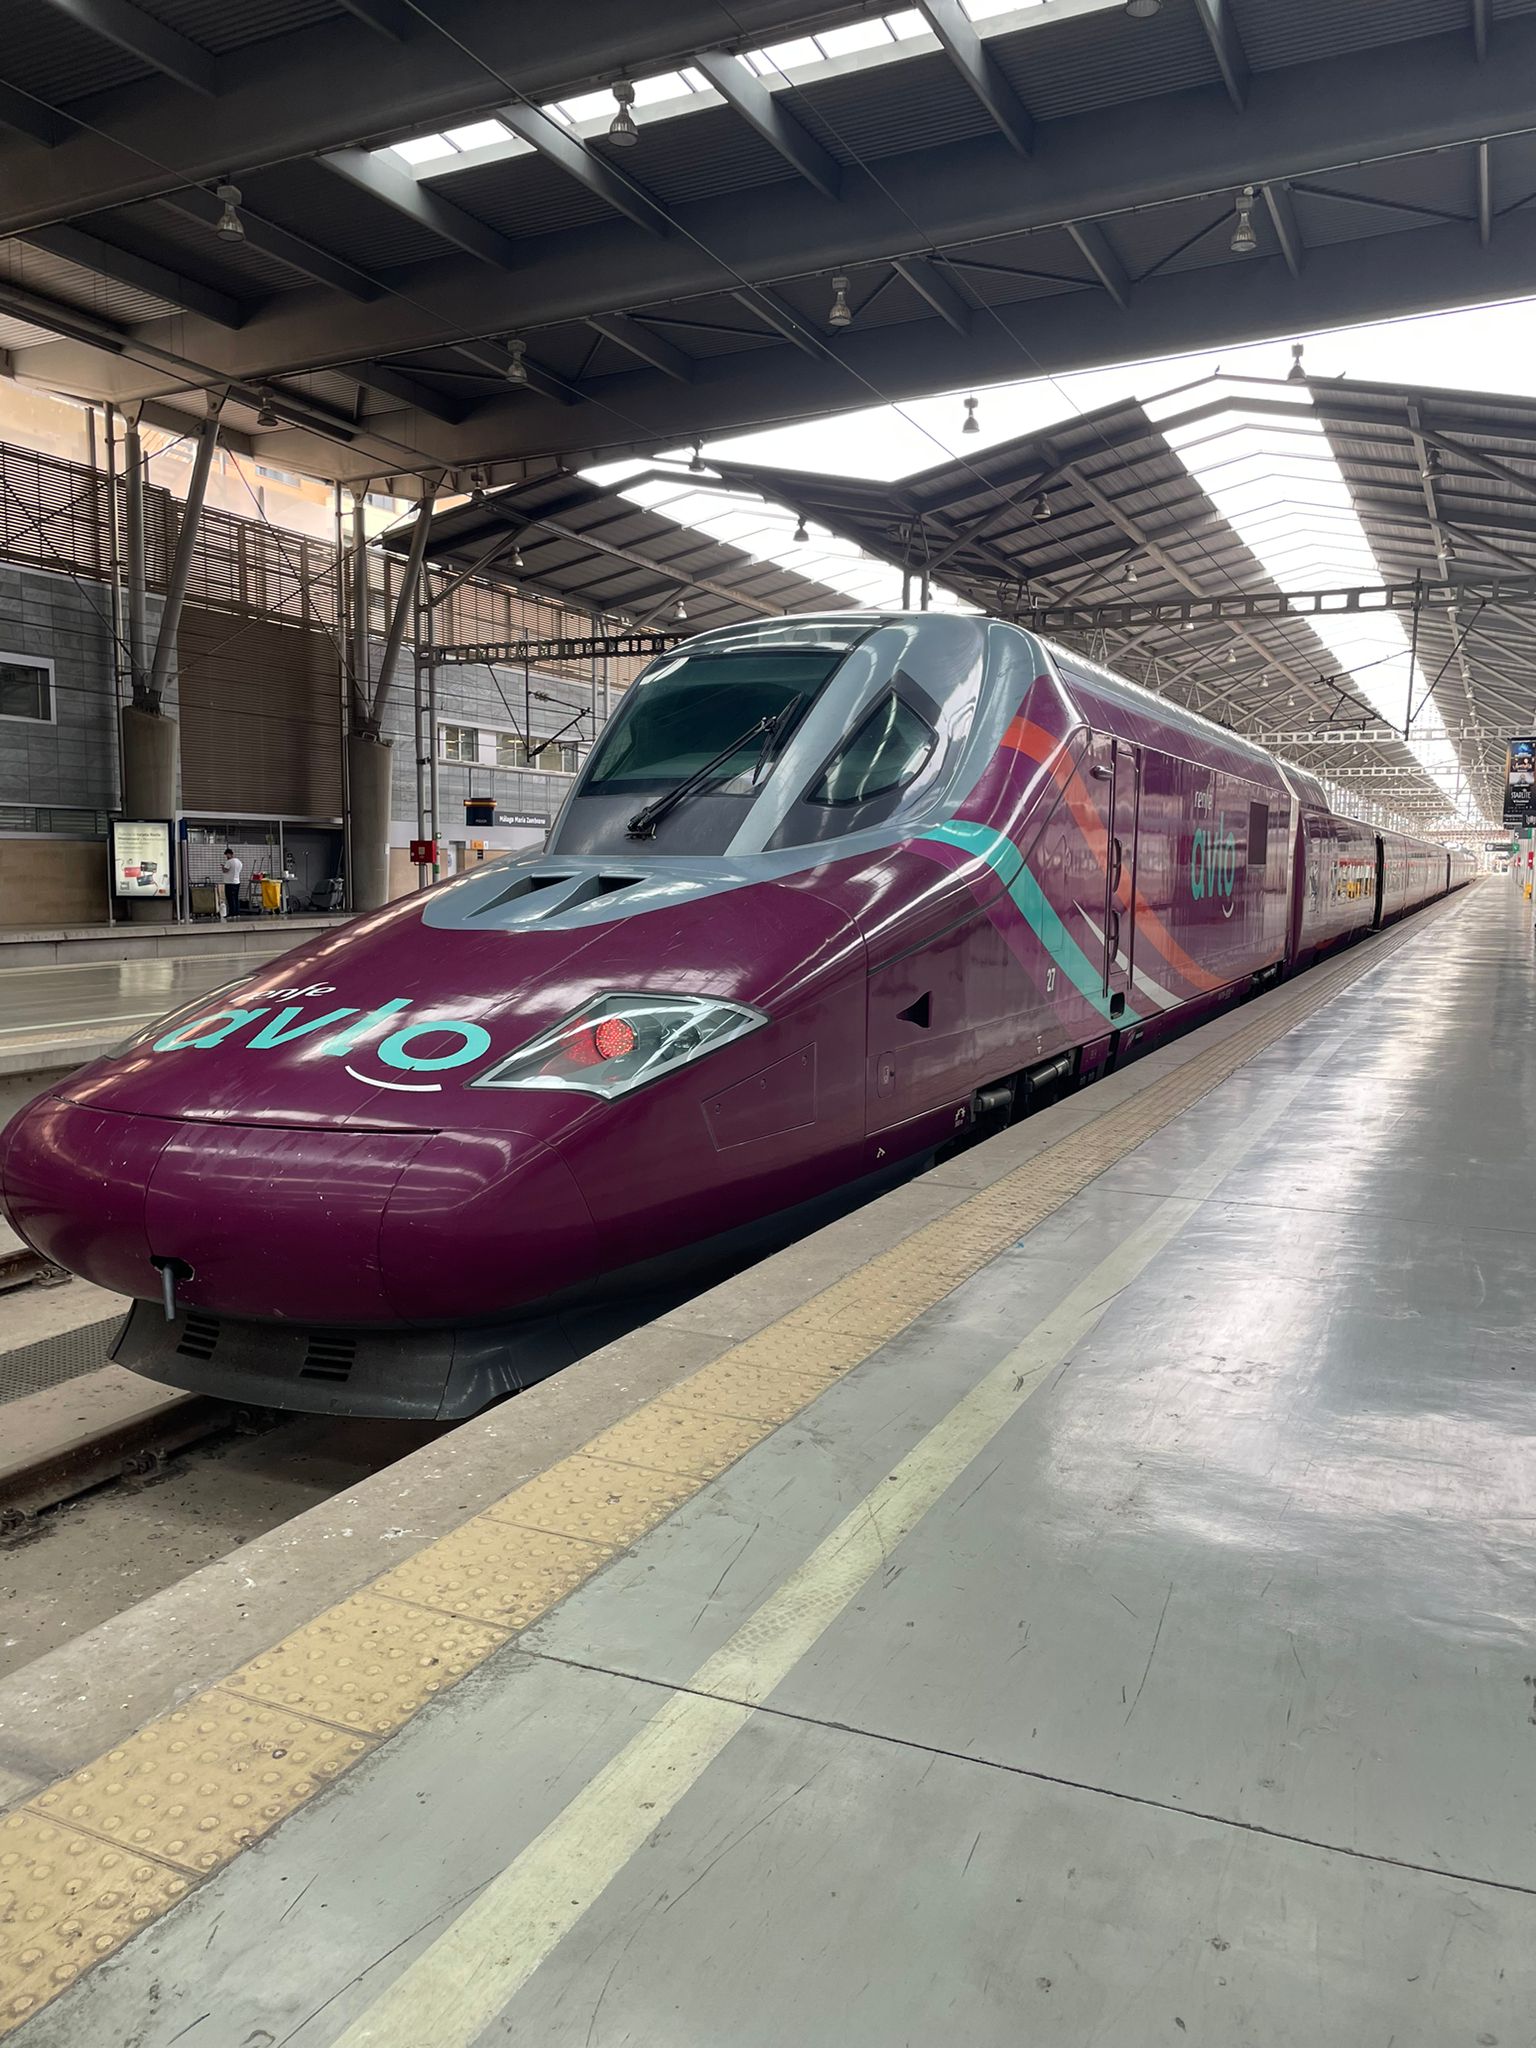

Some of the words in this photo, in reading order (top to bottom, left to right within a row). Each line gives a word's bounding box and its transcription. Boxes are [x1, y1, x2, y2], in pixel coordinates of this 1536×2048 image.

[1511, 791, 1532, 799] STARLITE
[1191, 811, 1235, 900] avlo
[1047, 968, 1056, 992] 27
[153, 998, 491, 1071] avlo
